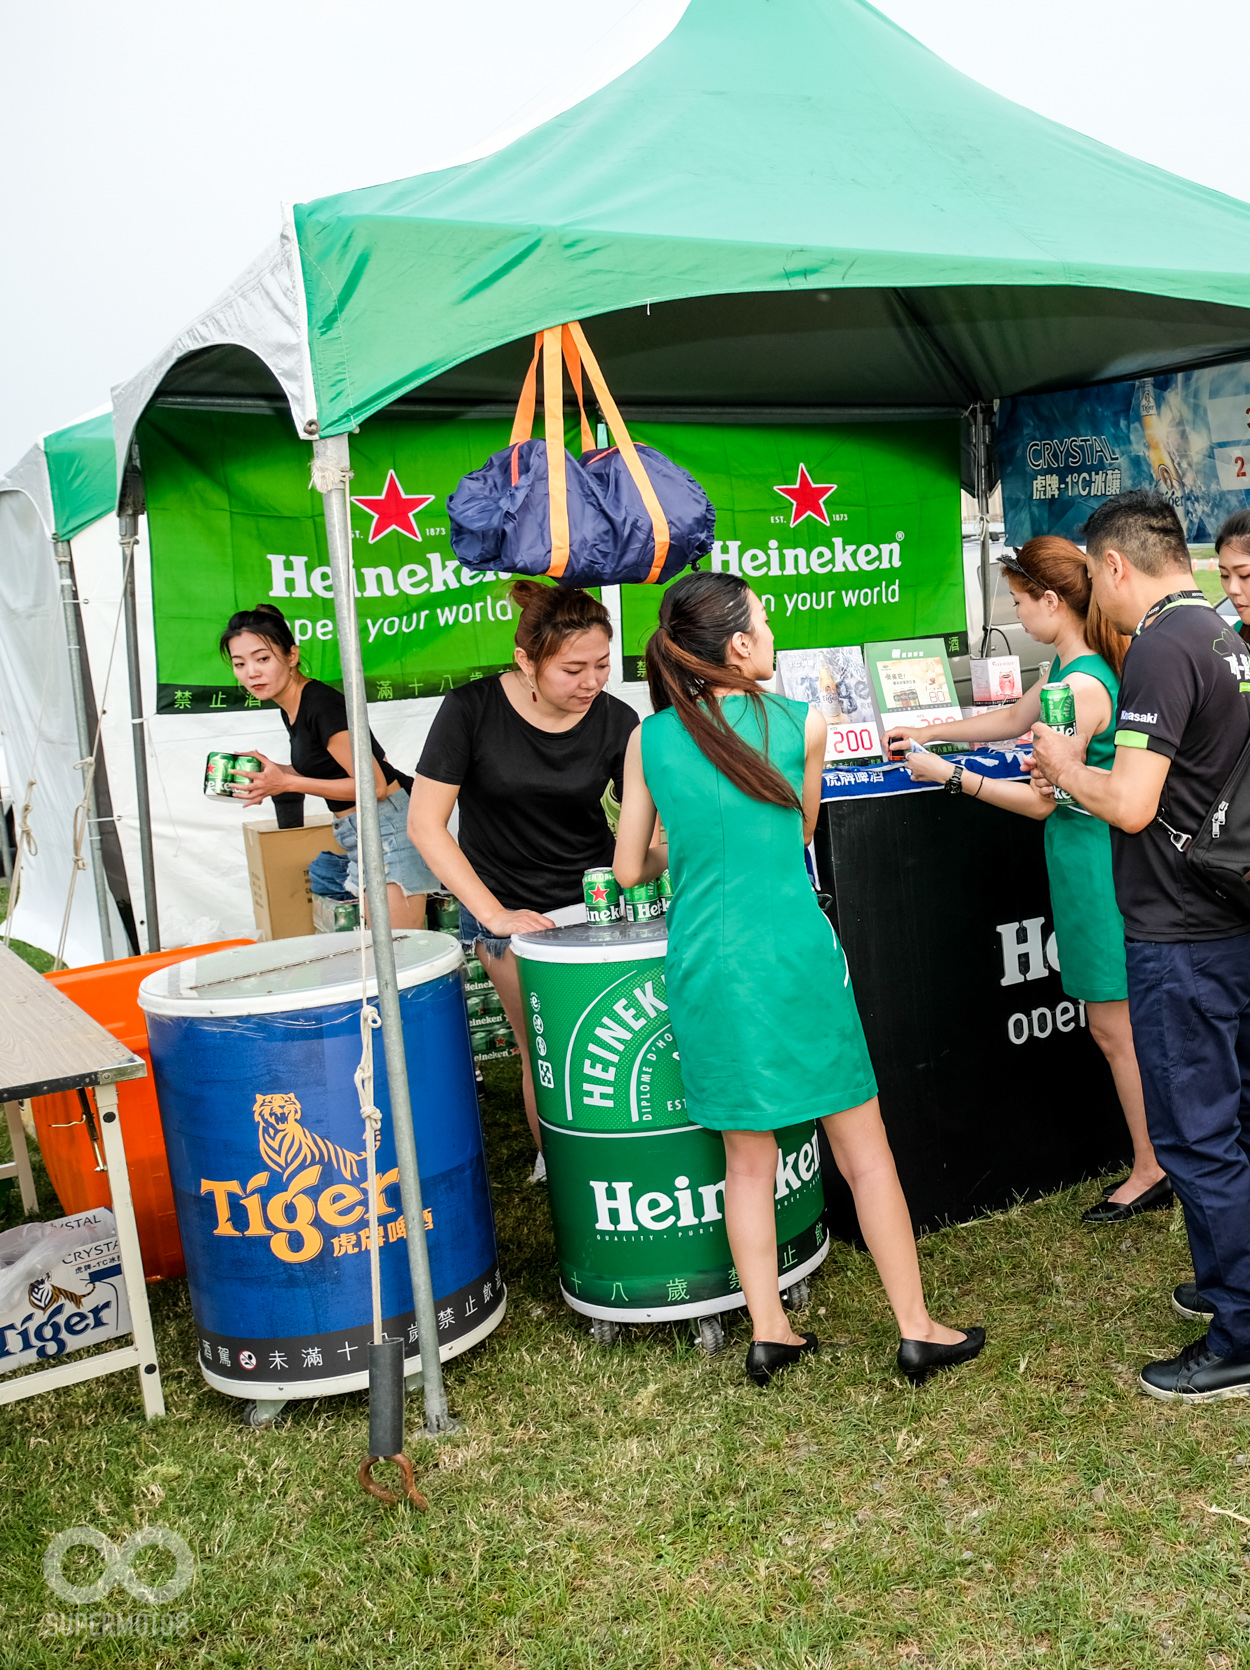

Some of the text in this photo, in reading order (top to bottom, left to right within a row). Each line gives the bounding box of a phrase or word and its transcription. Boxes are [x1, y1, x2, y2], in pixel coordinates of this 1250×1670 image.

[1026, 435, 1121, 470] CRYSTAL
[425, 527, 446, 537] 1873
[770, 513, 848, 524] EST. 1873
[711, 536, 902, 577] Heineken
[784, 590, 836, 617] your
[842, 579, 900, 609] world
[367, 609, 430, 643] your
[437, 594, 513, 628] world
[833, 728, 874, 754] 200
[468, 1012, 503, 1028] eineken
[473, 1050, 510, 1063] eineken
[582, 974, 670, 1108] HEINEK
[640, 1065, 653, 1121] DIPLOME
[200, 1164, 400, 1264] Tiger
